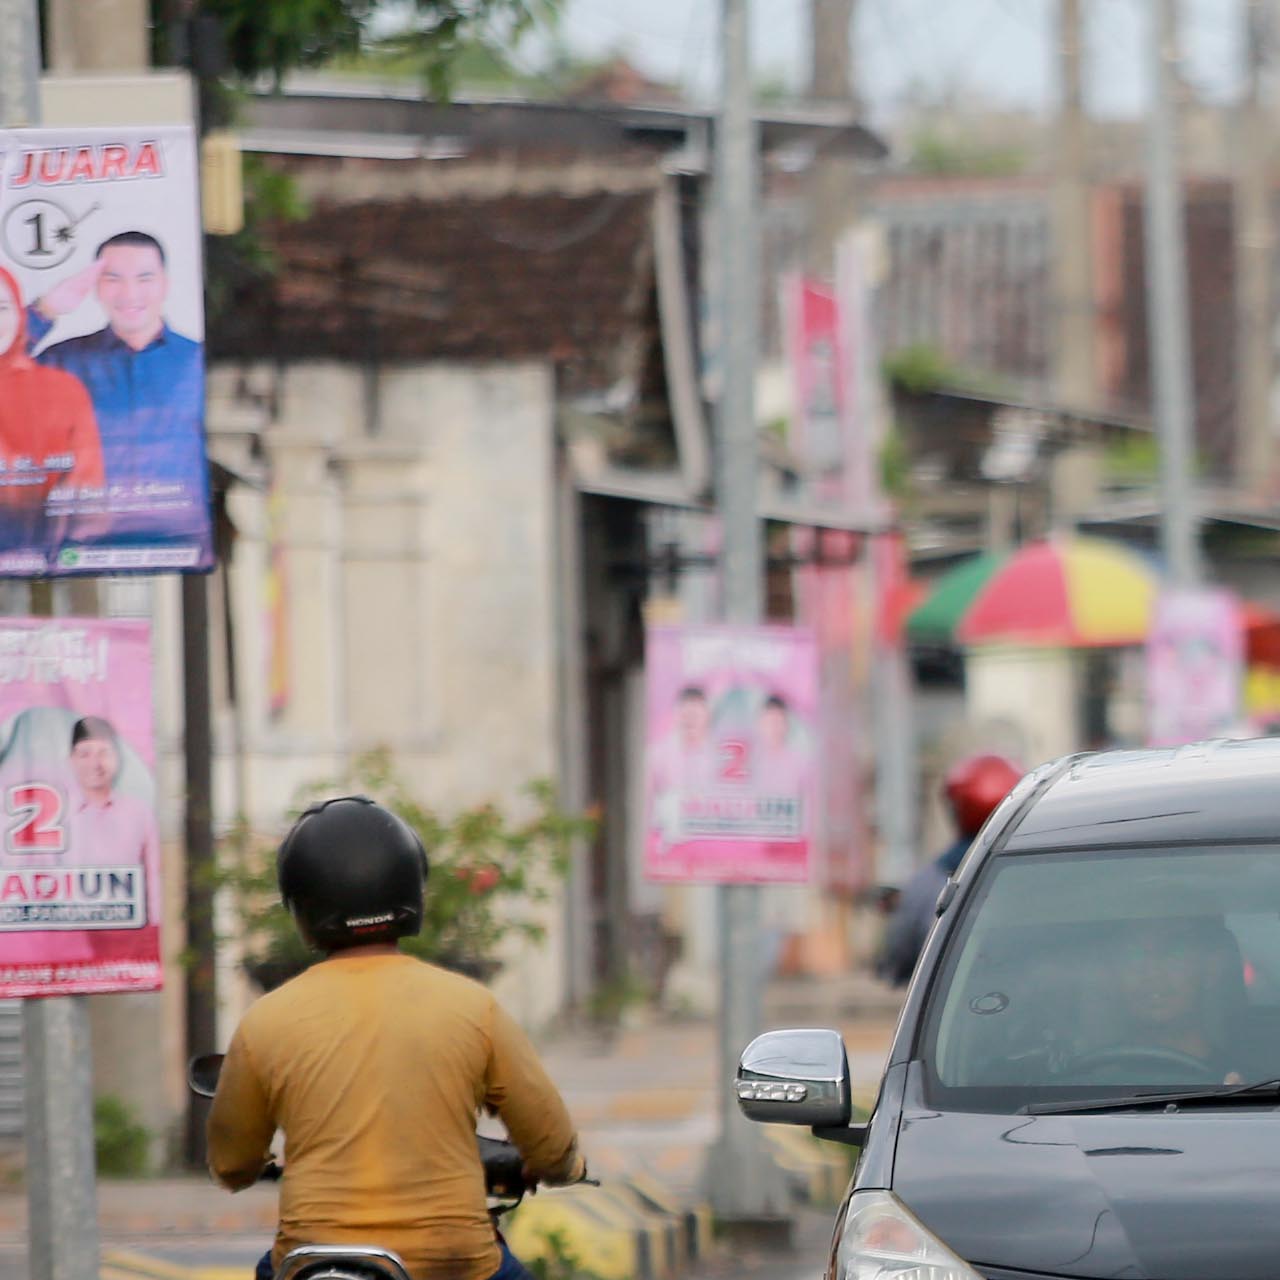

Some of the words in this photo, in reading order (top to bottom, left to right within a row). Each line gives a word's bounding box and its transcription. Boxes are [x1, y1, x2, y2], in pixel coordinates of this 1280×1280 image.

[9, 142, 164, 188] JUARA
[24, 213, 53, 256] 1
[10, 786, 65, 850] 2
